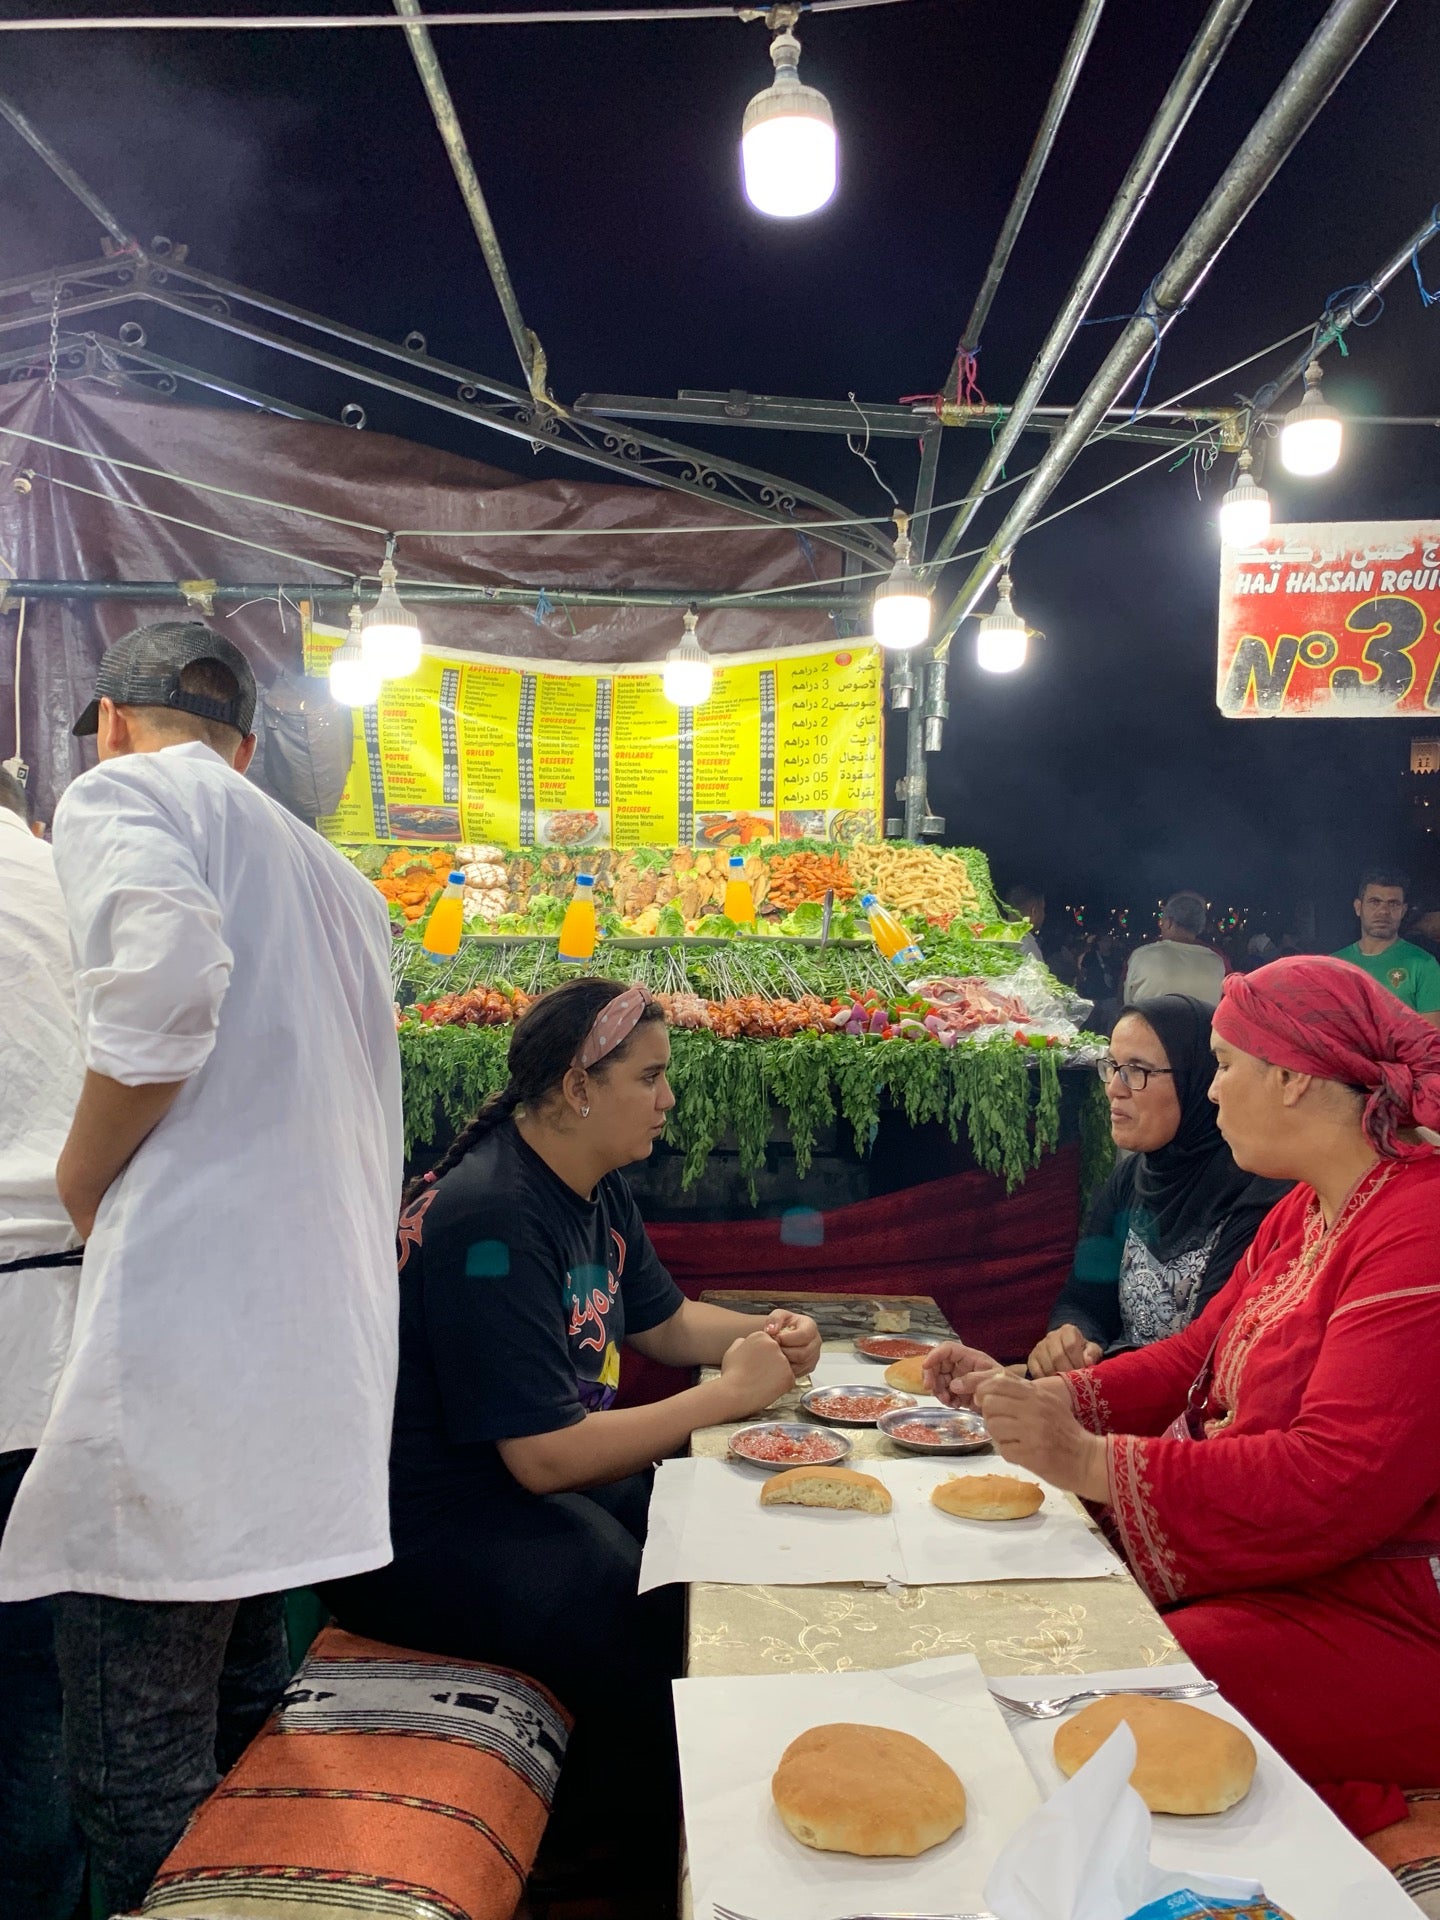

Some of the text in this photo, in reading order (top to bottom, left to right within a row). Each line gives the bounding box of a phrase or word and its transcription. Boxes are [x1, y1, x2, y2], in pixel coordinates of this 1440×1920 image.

[1234, 568, 1440, 594] HAJ HASSAN RGUI
[791, 666, 818, 679] دراهم
[821, 662, 829, 672] 2
[791, 678, 877, 694] لاصوص 3 دراهم
[791, 698, 818, 712] دراهم
[821, 697, 829, 709] 2
[791, 715, 876, 731] شاي 2 دراهم
[784, 736, 810, 750] دراهم
[814, 734, 828, 746] 10
[466, 749, 495, 757] GRILLED
[615, 751, 654, 759] GRILLADES
[813, 753, 829, 765] 05
[540, 757, 575, 765] DESSERTS
[697, 758, 731, 766] DESSERTS
[784, 754, 810, 769] دراهم
[783, 773, 810, 787] دراهم
[813, 771, 829, 783] 05
[783, 791, 810, 805] دراهم
[813, 789, 829, 801] 05
